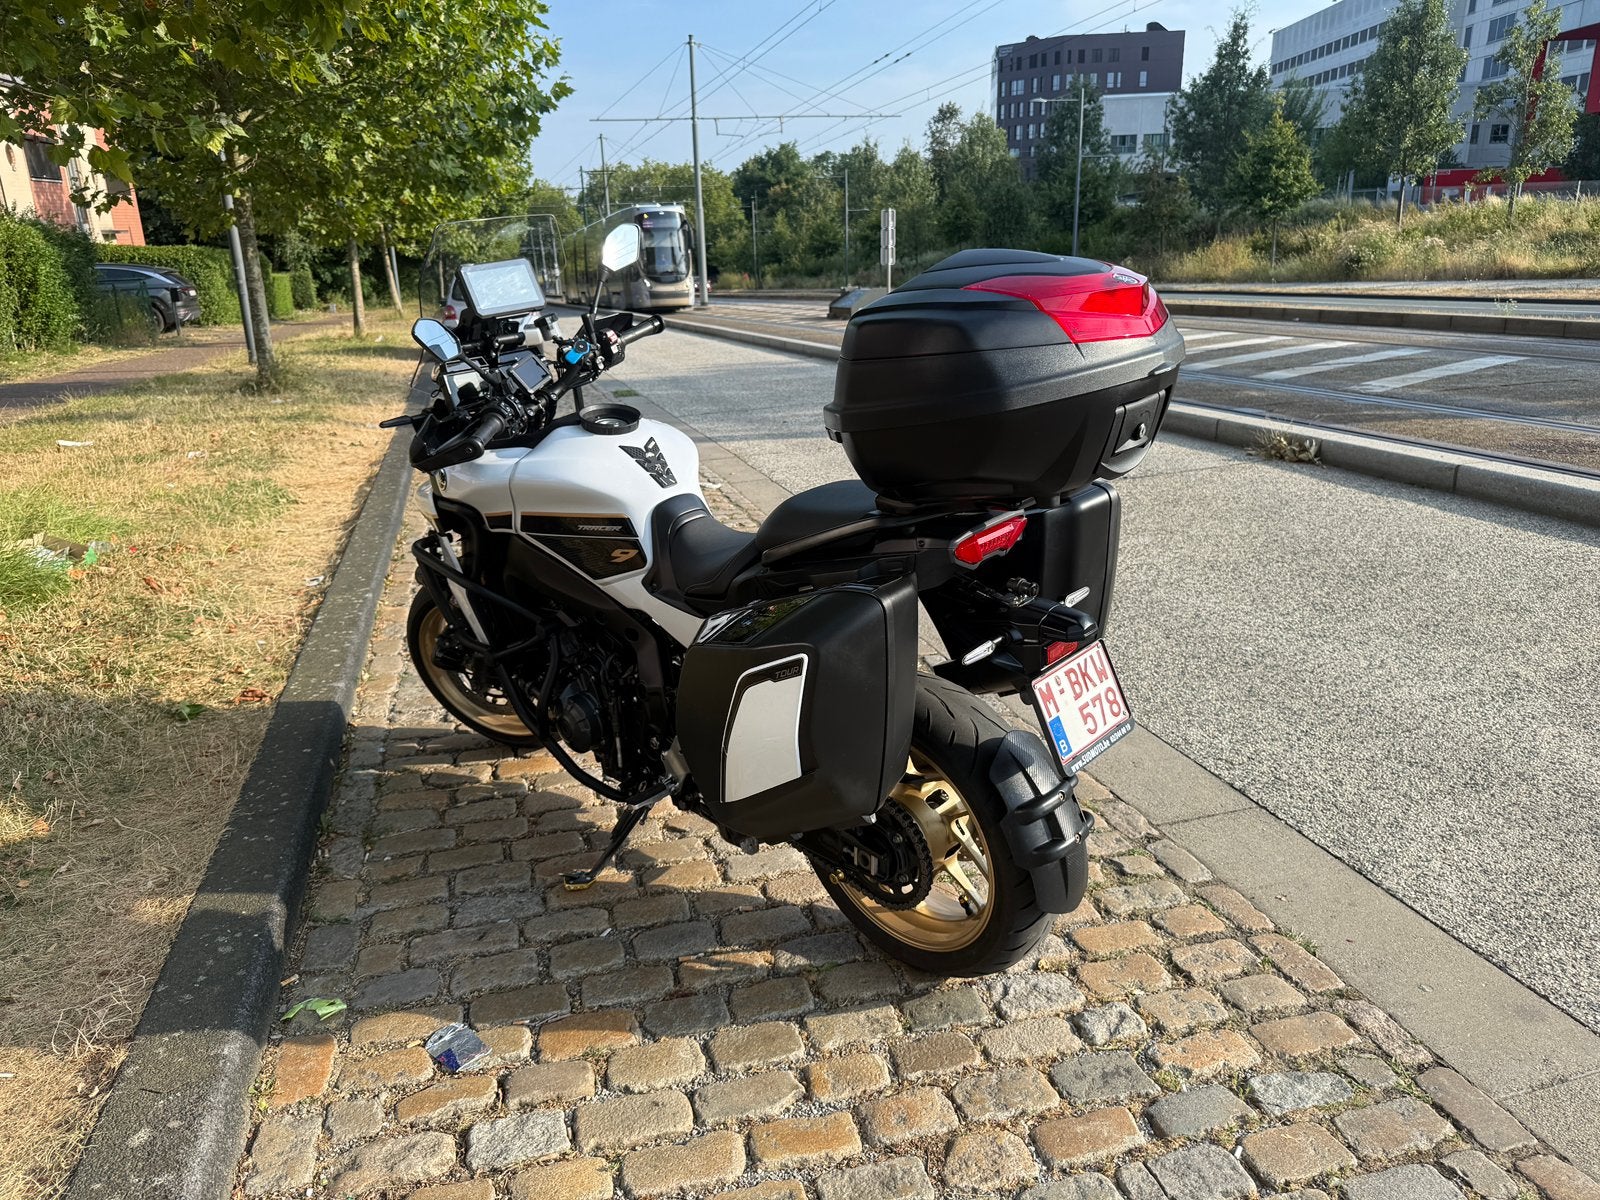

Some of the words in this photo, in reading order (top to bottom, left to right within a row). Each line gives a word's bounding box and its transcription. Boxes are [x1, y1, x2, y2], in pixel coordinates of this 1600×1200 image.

[577, 524, 623, 532] TRACER
[609, 548, 640, 563] 9
[775, 666, 800, 679] TOUR
[1078, 686, 1121, 735] 578
[1059, 739, 1068, 754] B
